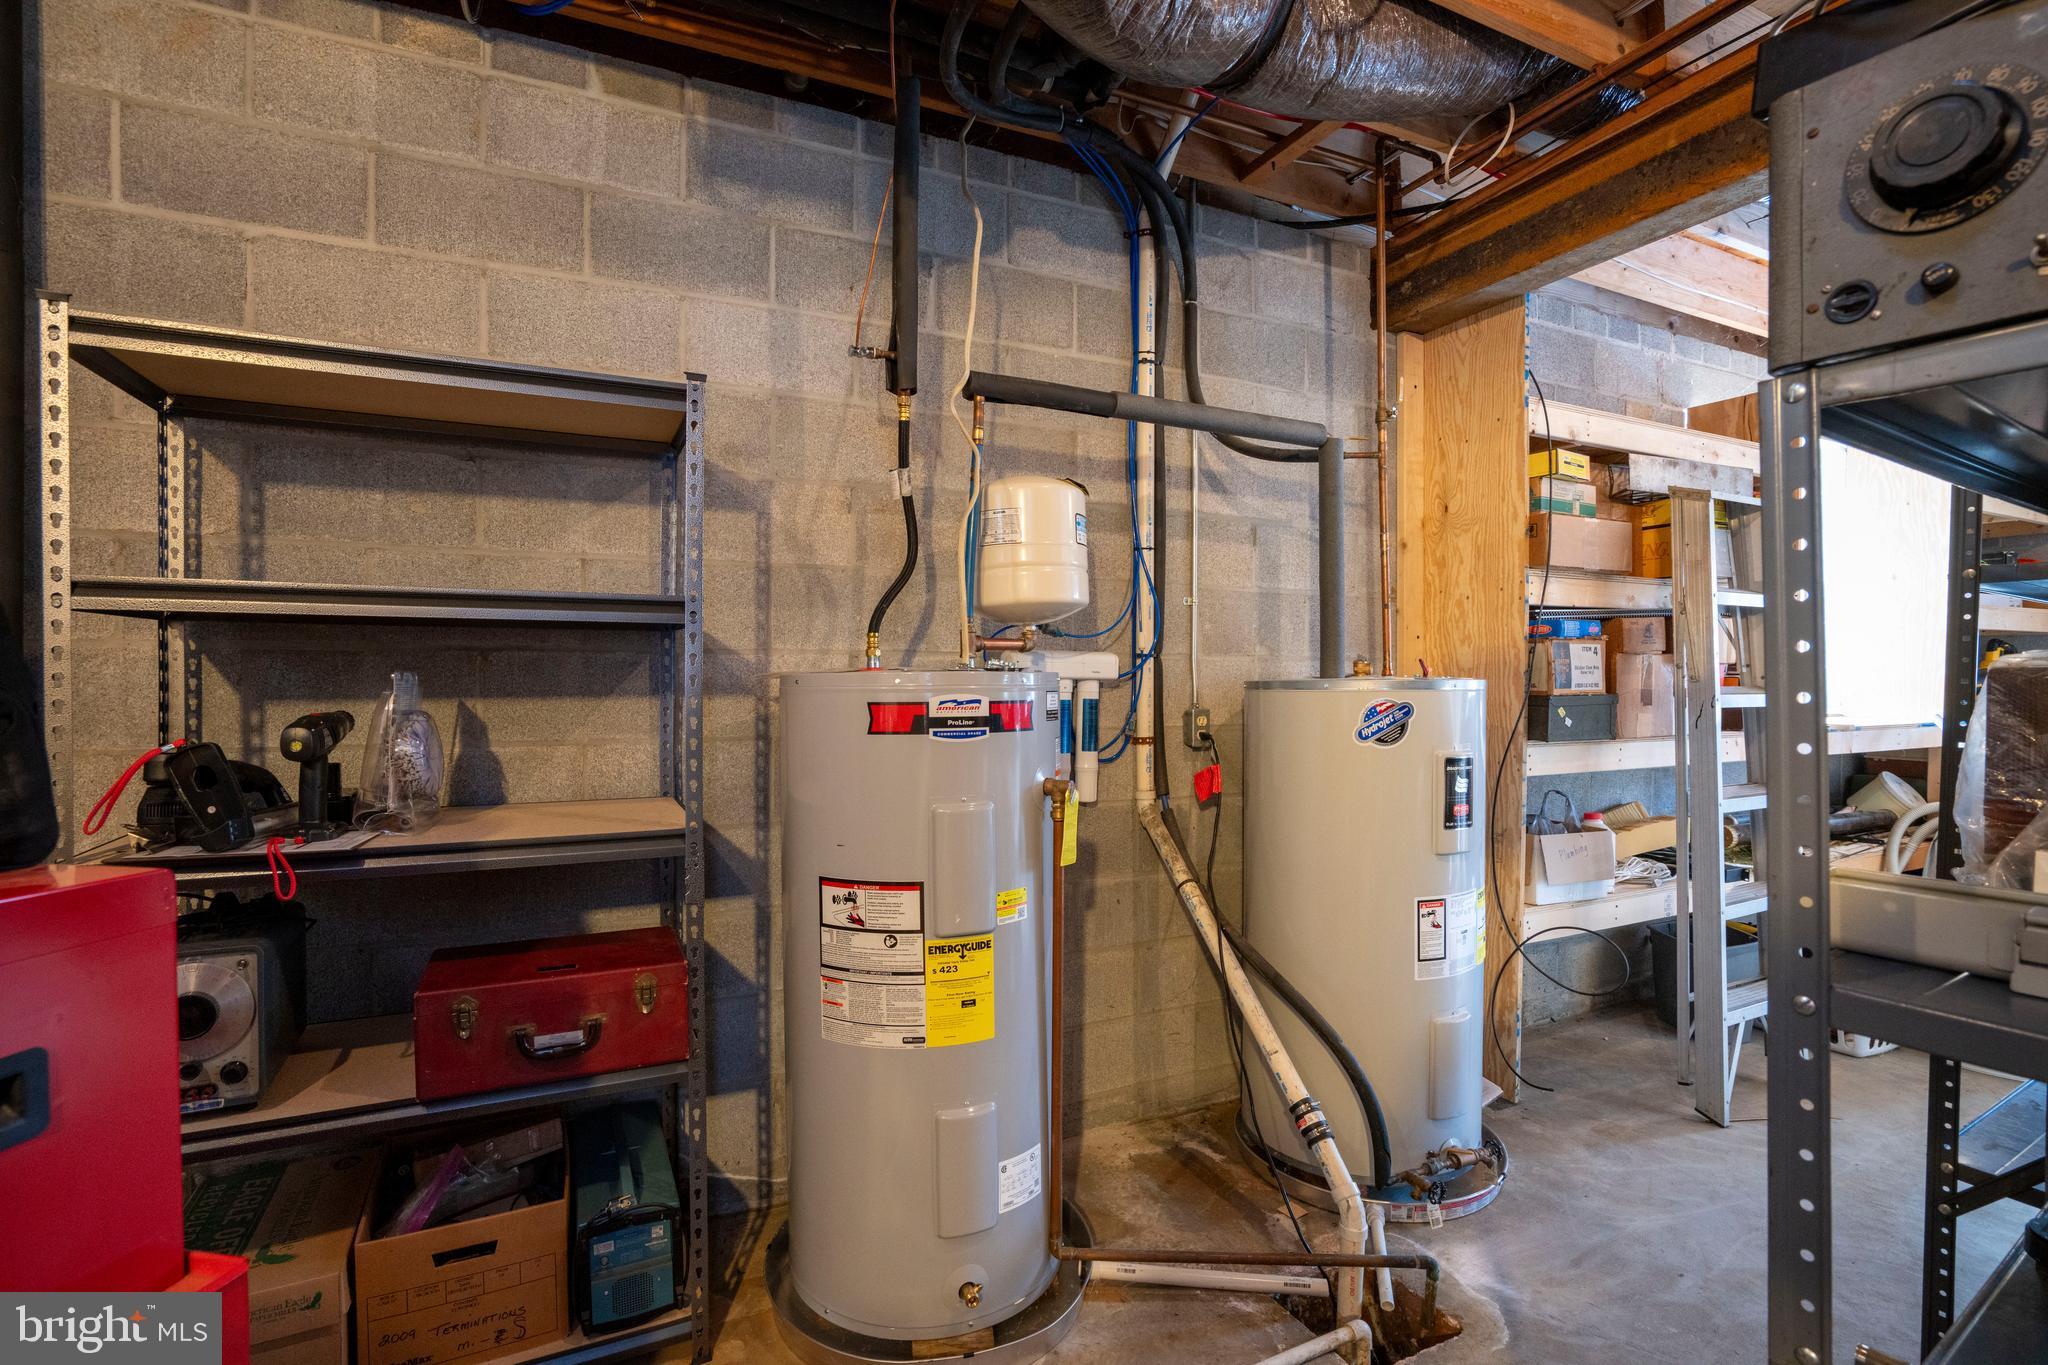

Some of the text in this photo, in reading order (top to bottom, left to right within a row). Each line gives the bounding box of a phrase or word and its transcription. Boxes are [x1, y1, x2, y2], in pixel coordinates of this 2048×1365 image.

[1986, 67, 2010, 82] 80
[1361, 713, 1394, 738] Hydrojet
[1558, 845, 1588, 862] Plumbing
[928, 940, 993, 956] ENERGYGUIDE
[939, 965, 958, 974] 423
[378, 1329, 416, 1347] 2009
